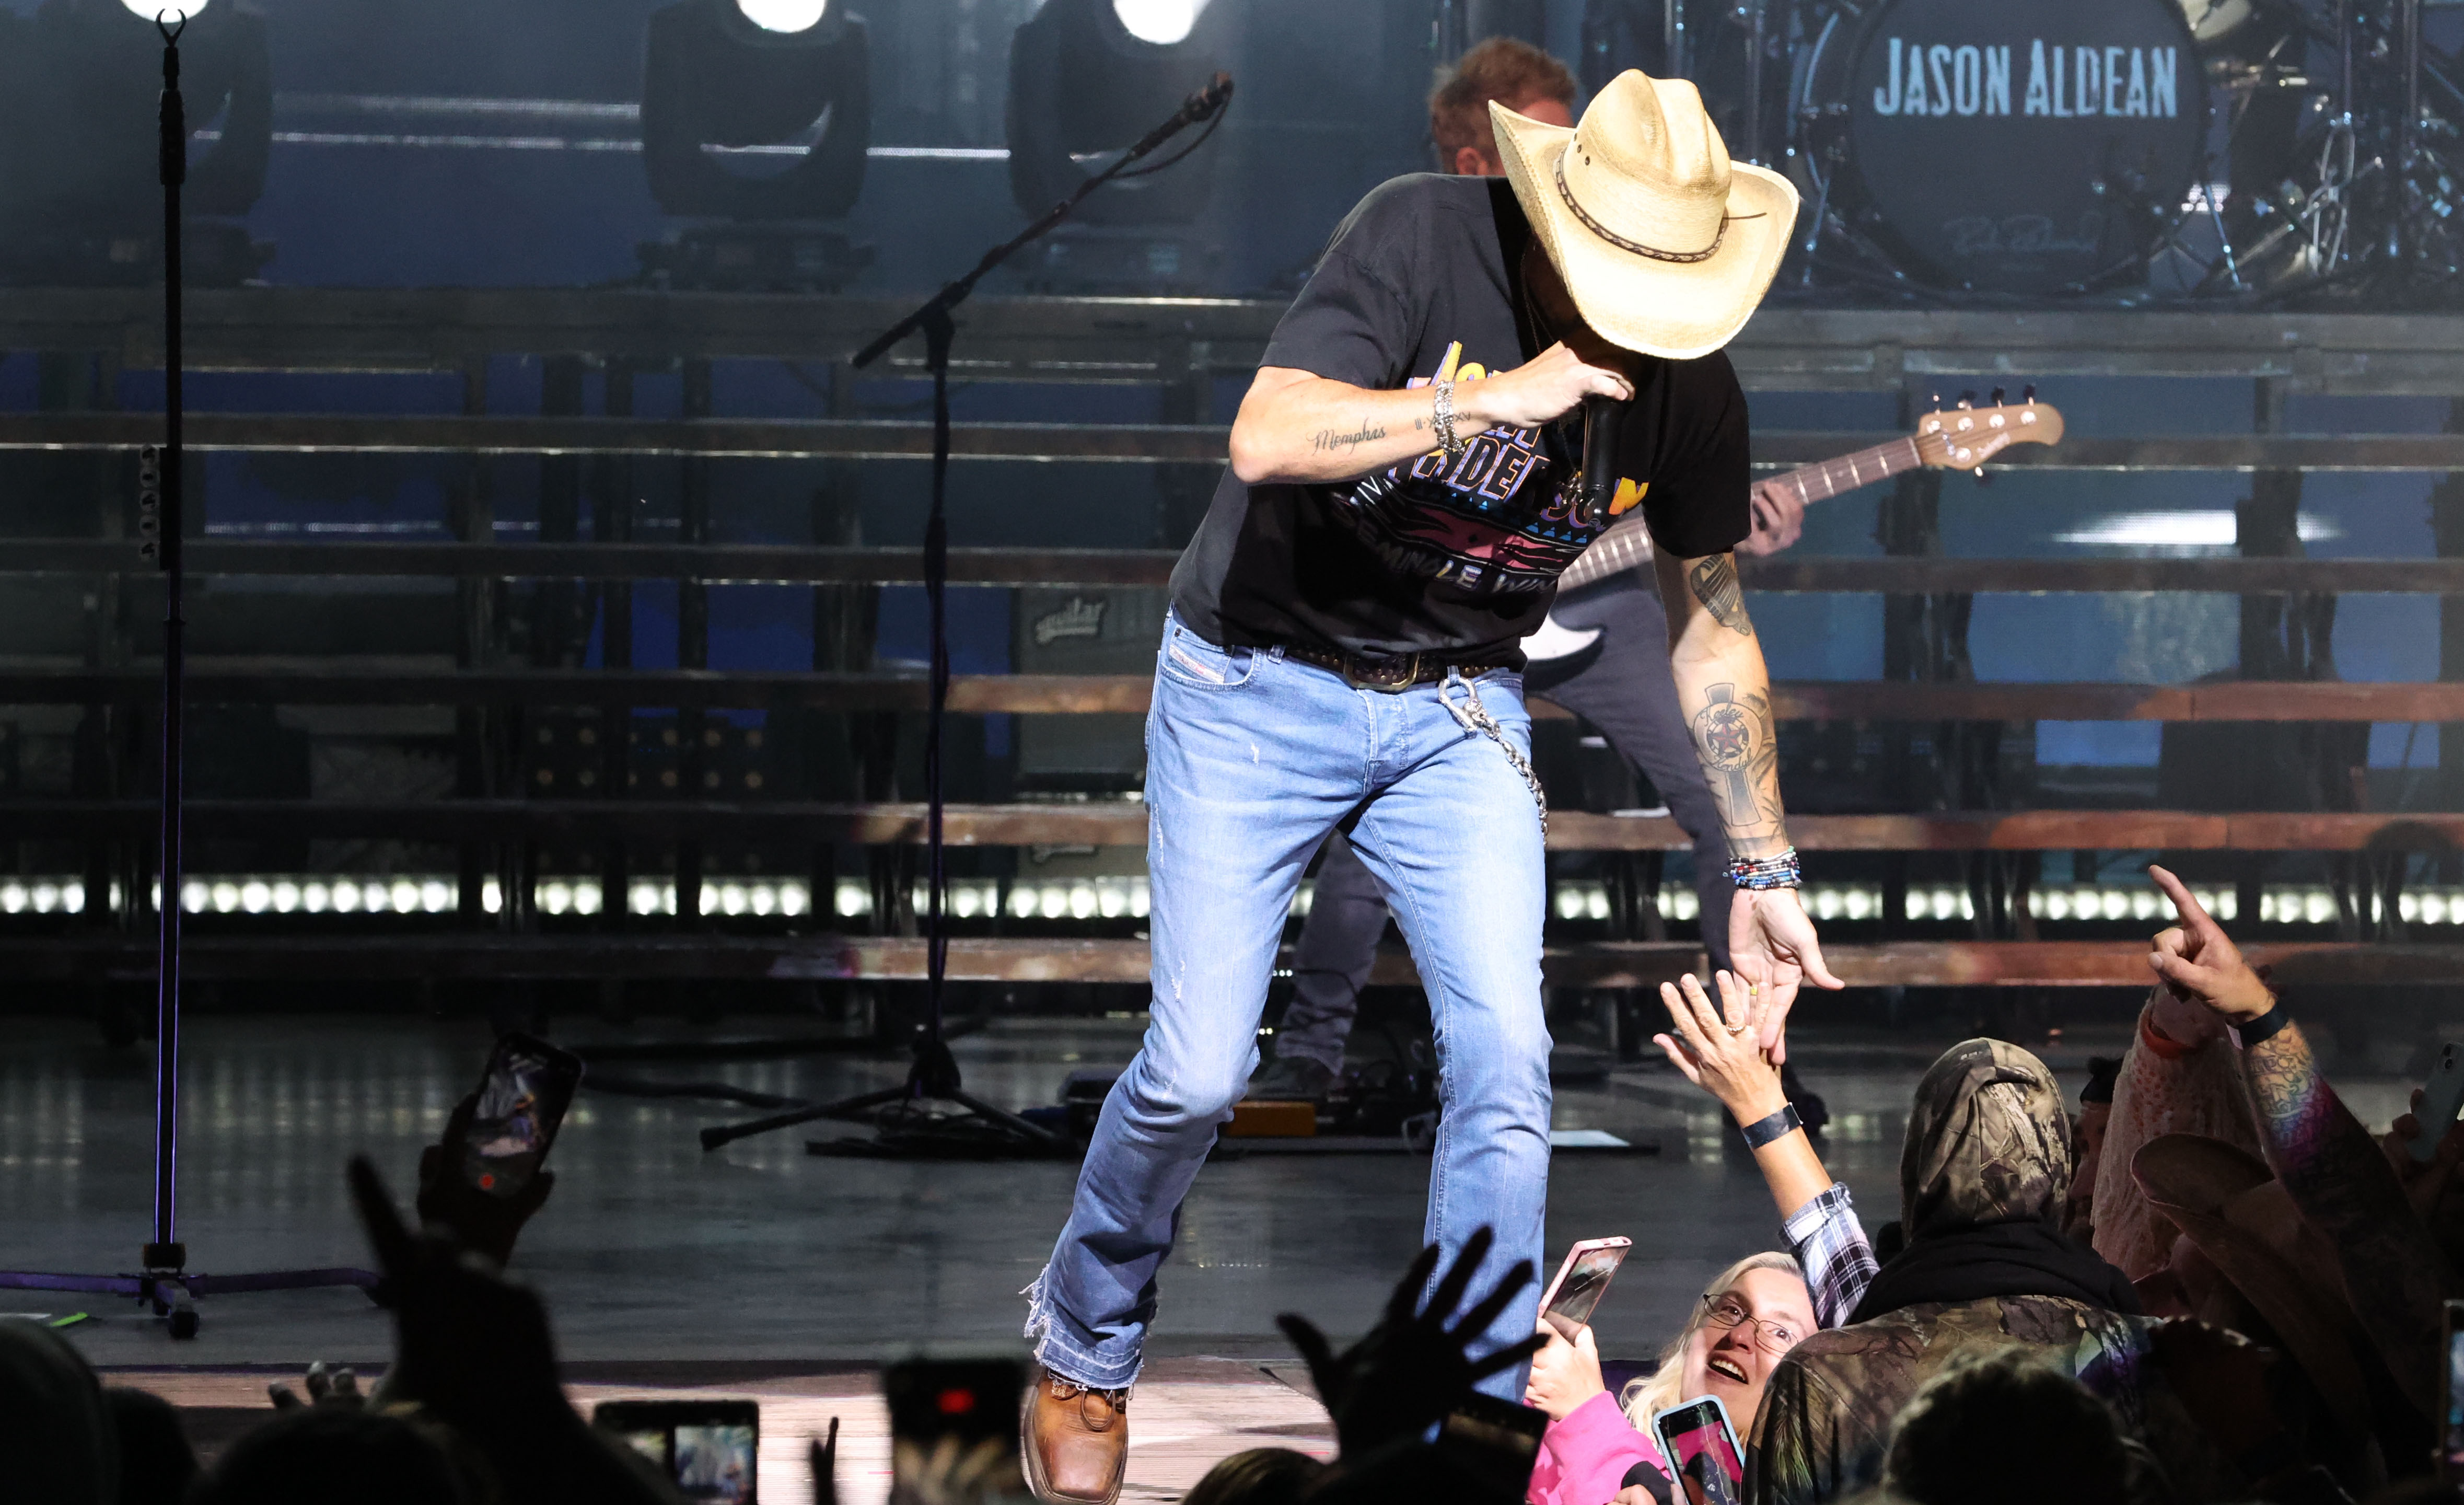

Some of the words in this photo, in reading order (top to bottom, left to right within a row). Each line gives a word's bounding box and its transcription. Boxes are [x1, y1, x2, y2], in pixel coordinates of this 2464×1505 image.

[1873, 37, 2011, 117] JASON
[2024, 38, 2178, 118] ALDEAN
[1306, 416, 1386, 456] Memphis
